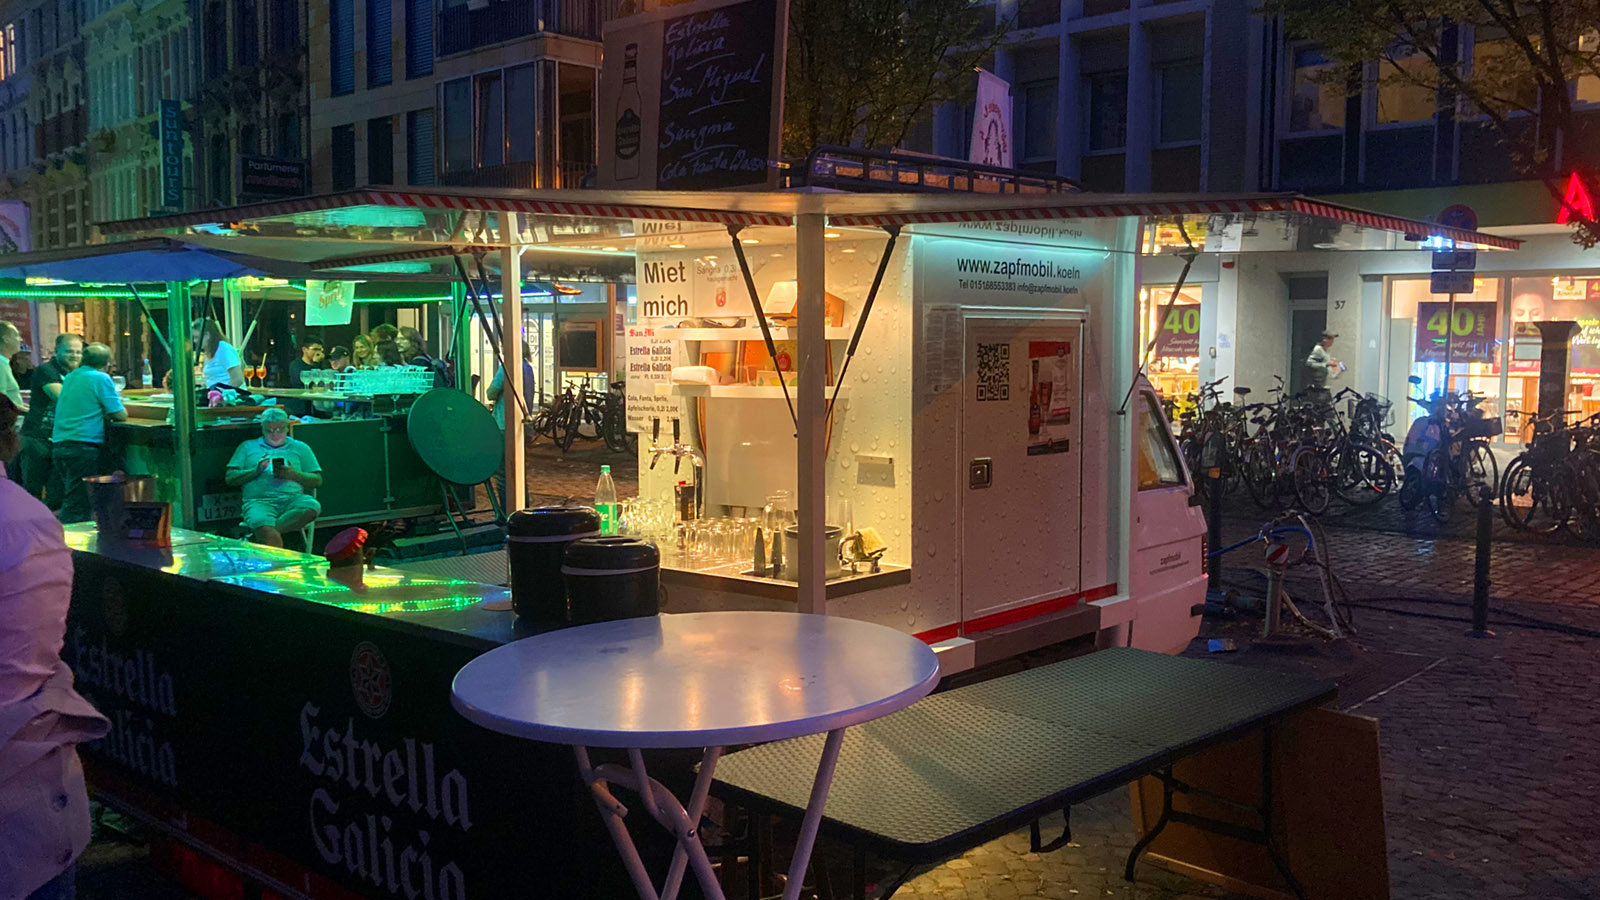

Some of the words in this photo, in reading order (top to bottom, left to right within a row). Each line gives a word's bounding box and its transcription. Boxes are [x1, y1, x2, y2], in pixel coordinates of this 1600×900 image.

[697, 53, 766, 104] Miguel
[644, 261, 686, 284] Miet
[957, 257, 1080, 280] www.zapfmobil.koeln
[958, 279, 969, 289] Tel
[643, 294, 688, 316] mich
[1334, 300, 1346, 310] 37
[1163, 308, 1200, 335] 40
[1426, 307, 1474, 337] 40
[630, 346, 650, 356] Estrella
[652, 346, 671, 355] Galicia
[630, 363, 650, 372] Estrella
[652, 363, 671, 372] Galicia
[299, 701, 473, 832] Estrella
[310, 788, 468, 900] Galicia
